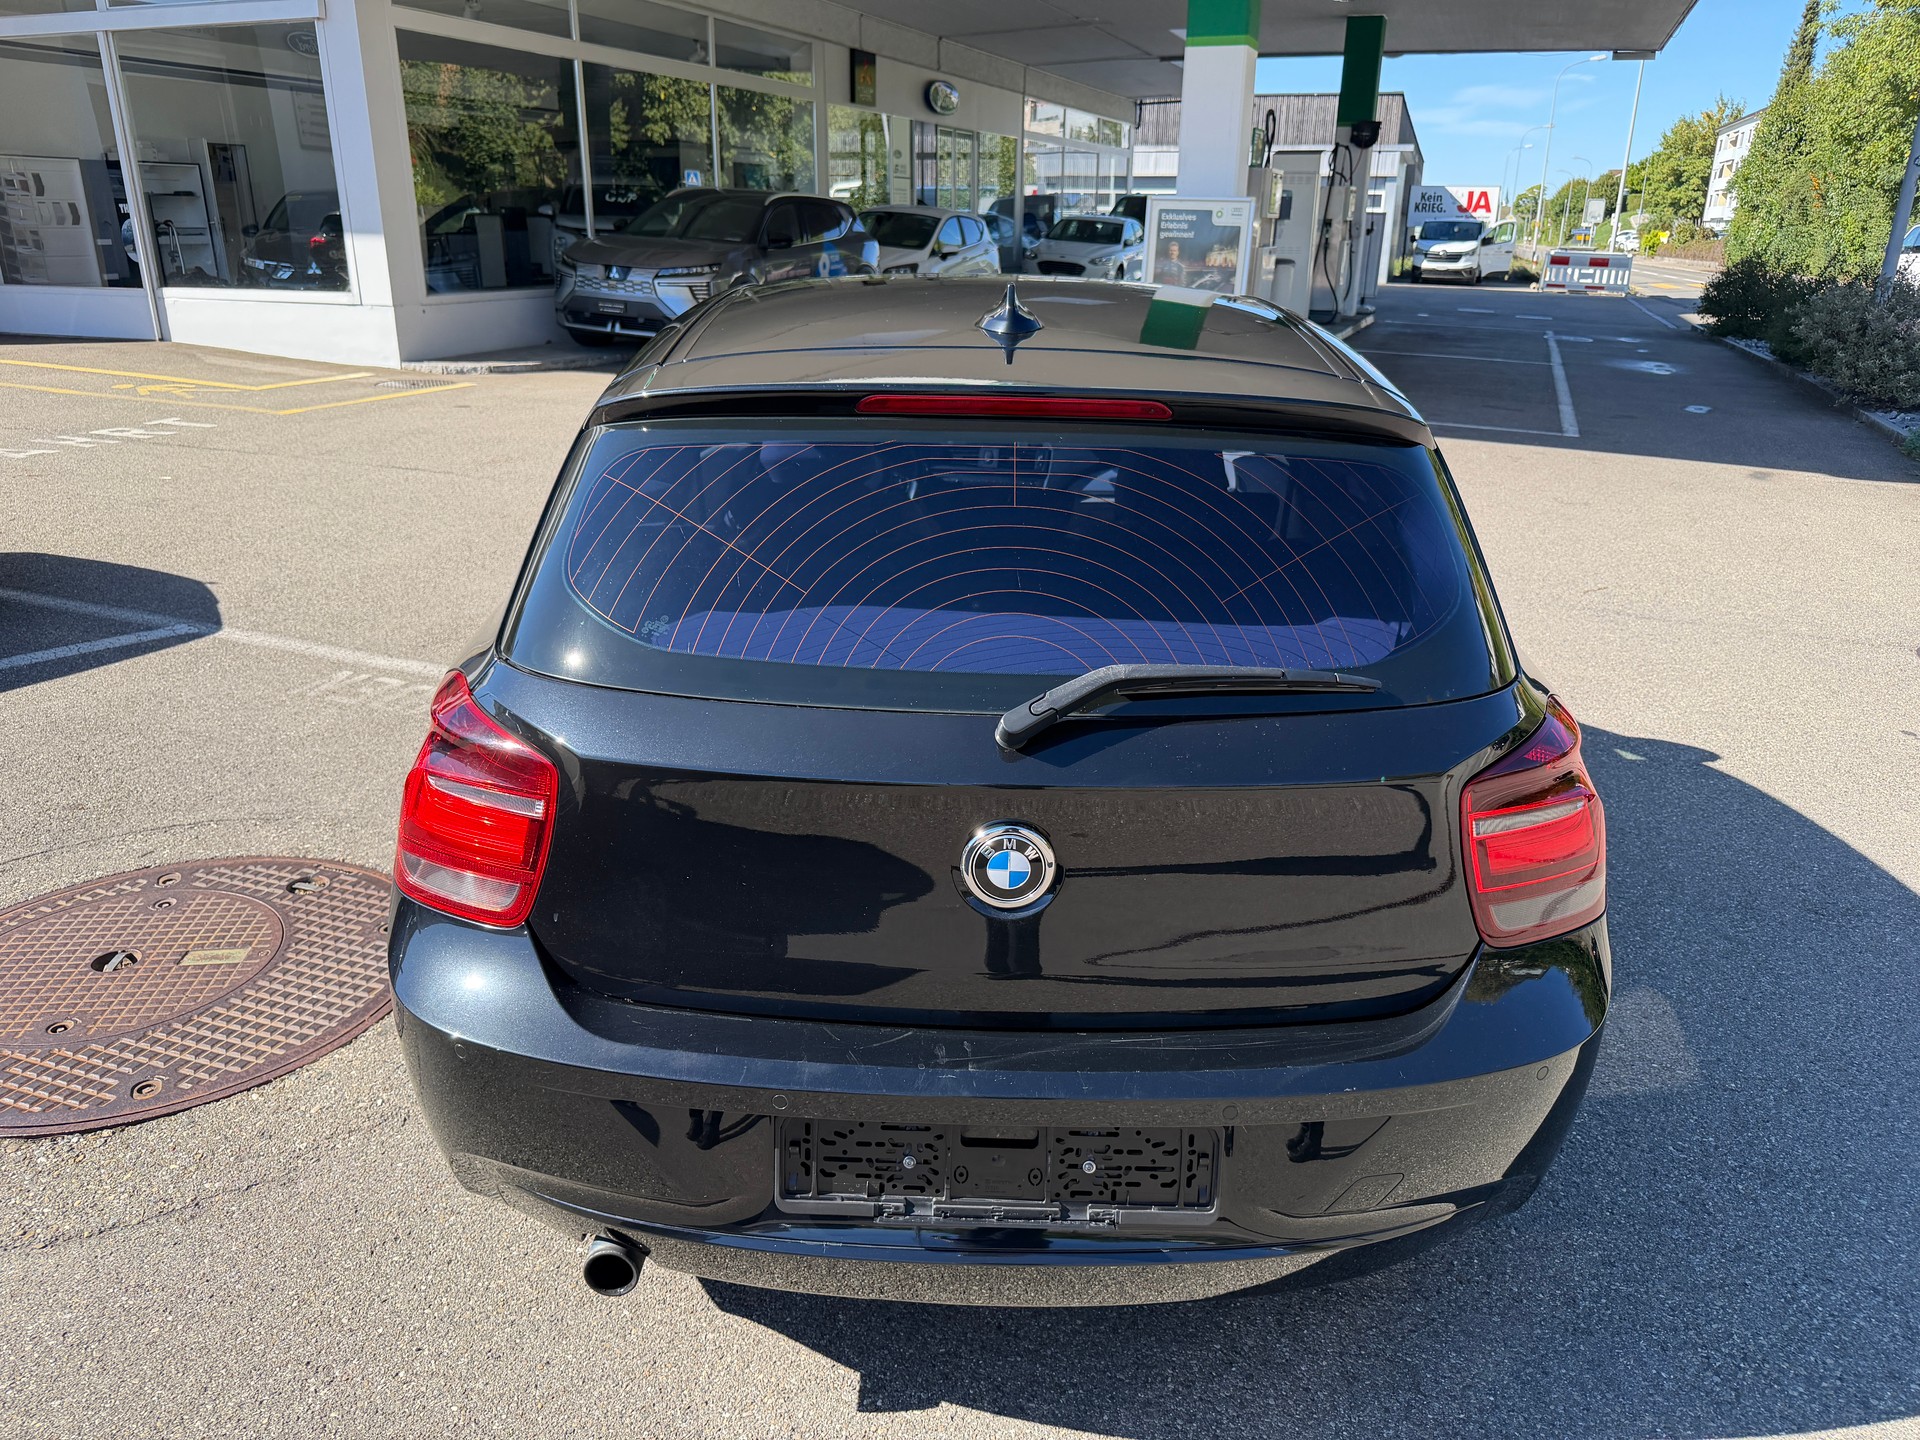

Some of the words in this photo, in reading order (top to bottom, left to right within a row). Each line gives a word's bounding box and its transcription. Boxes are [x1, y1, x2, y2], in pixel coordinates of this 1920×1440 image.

[1420, 192, 1443, 202] Kein
[1414, 202, 1447, 213] KRIEG.
[1456, 191, 1492, 214] JA
[1161, 212, 1197, 221] Exklusives
[1160, 221, 1189, 230] Erlebnis
[1159, 230, 1195, 239] gewinnen!
[981, 838, 1039, 861] BMW
